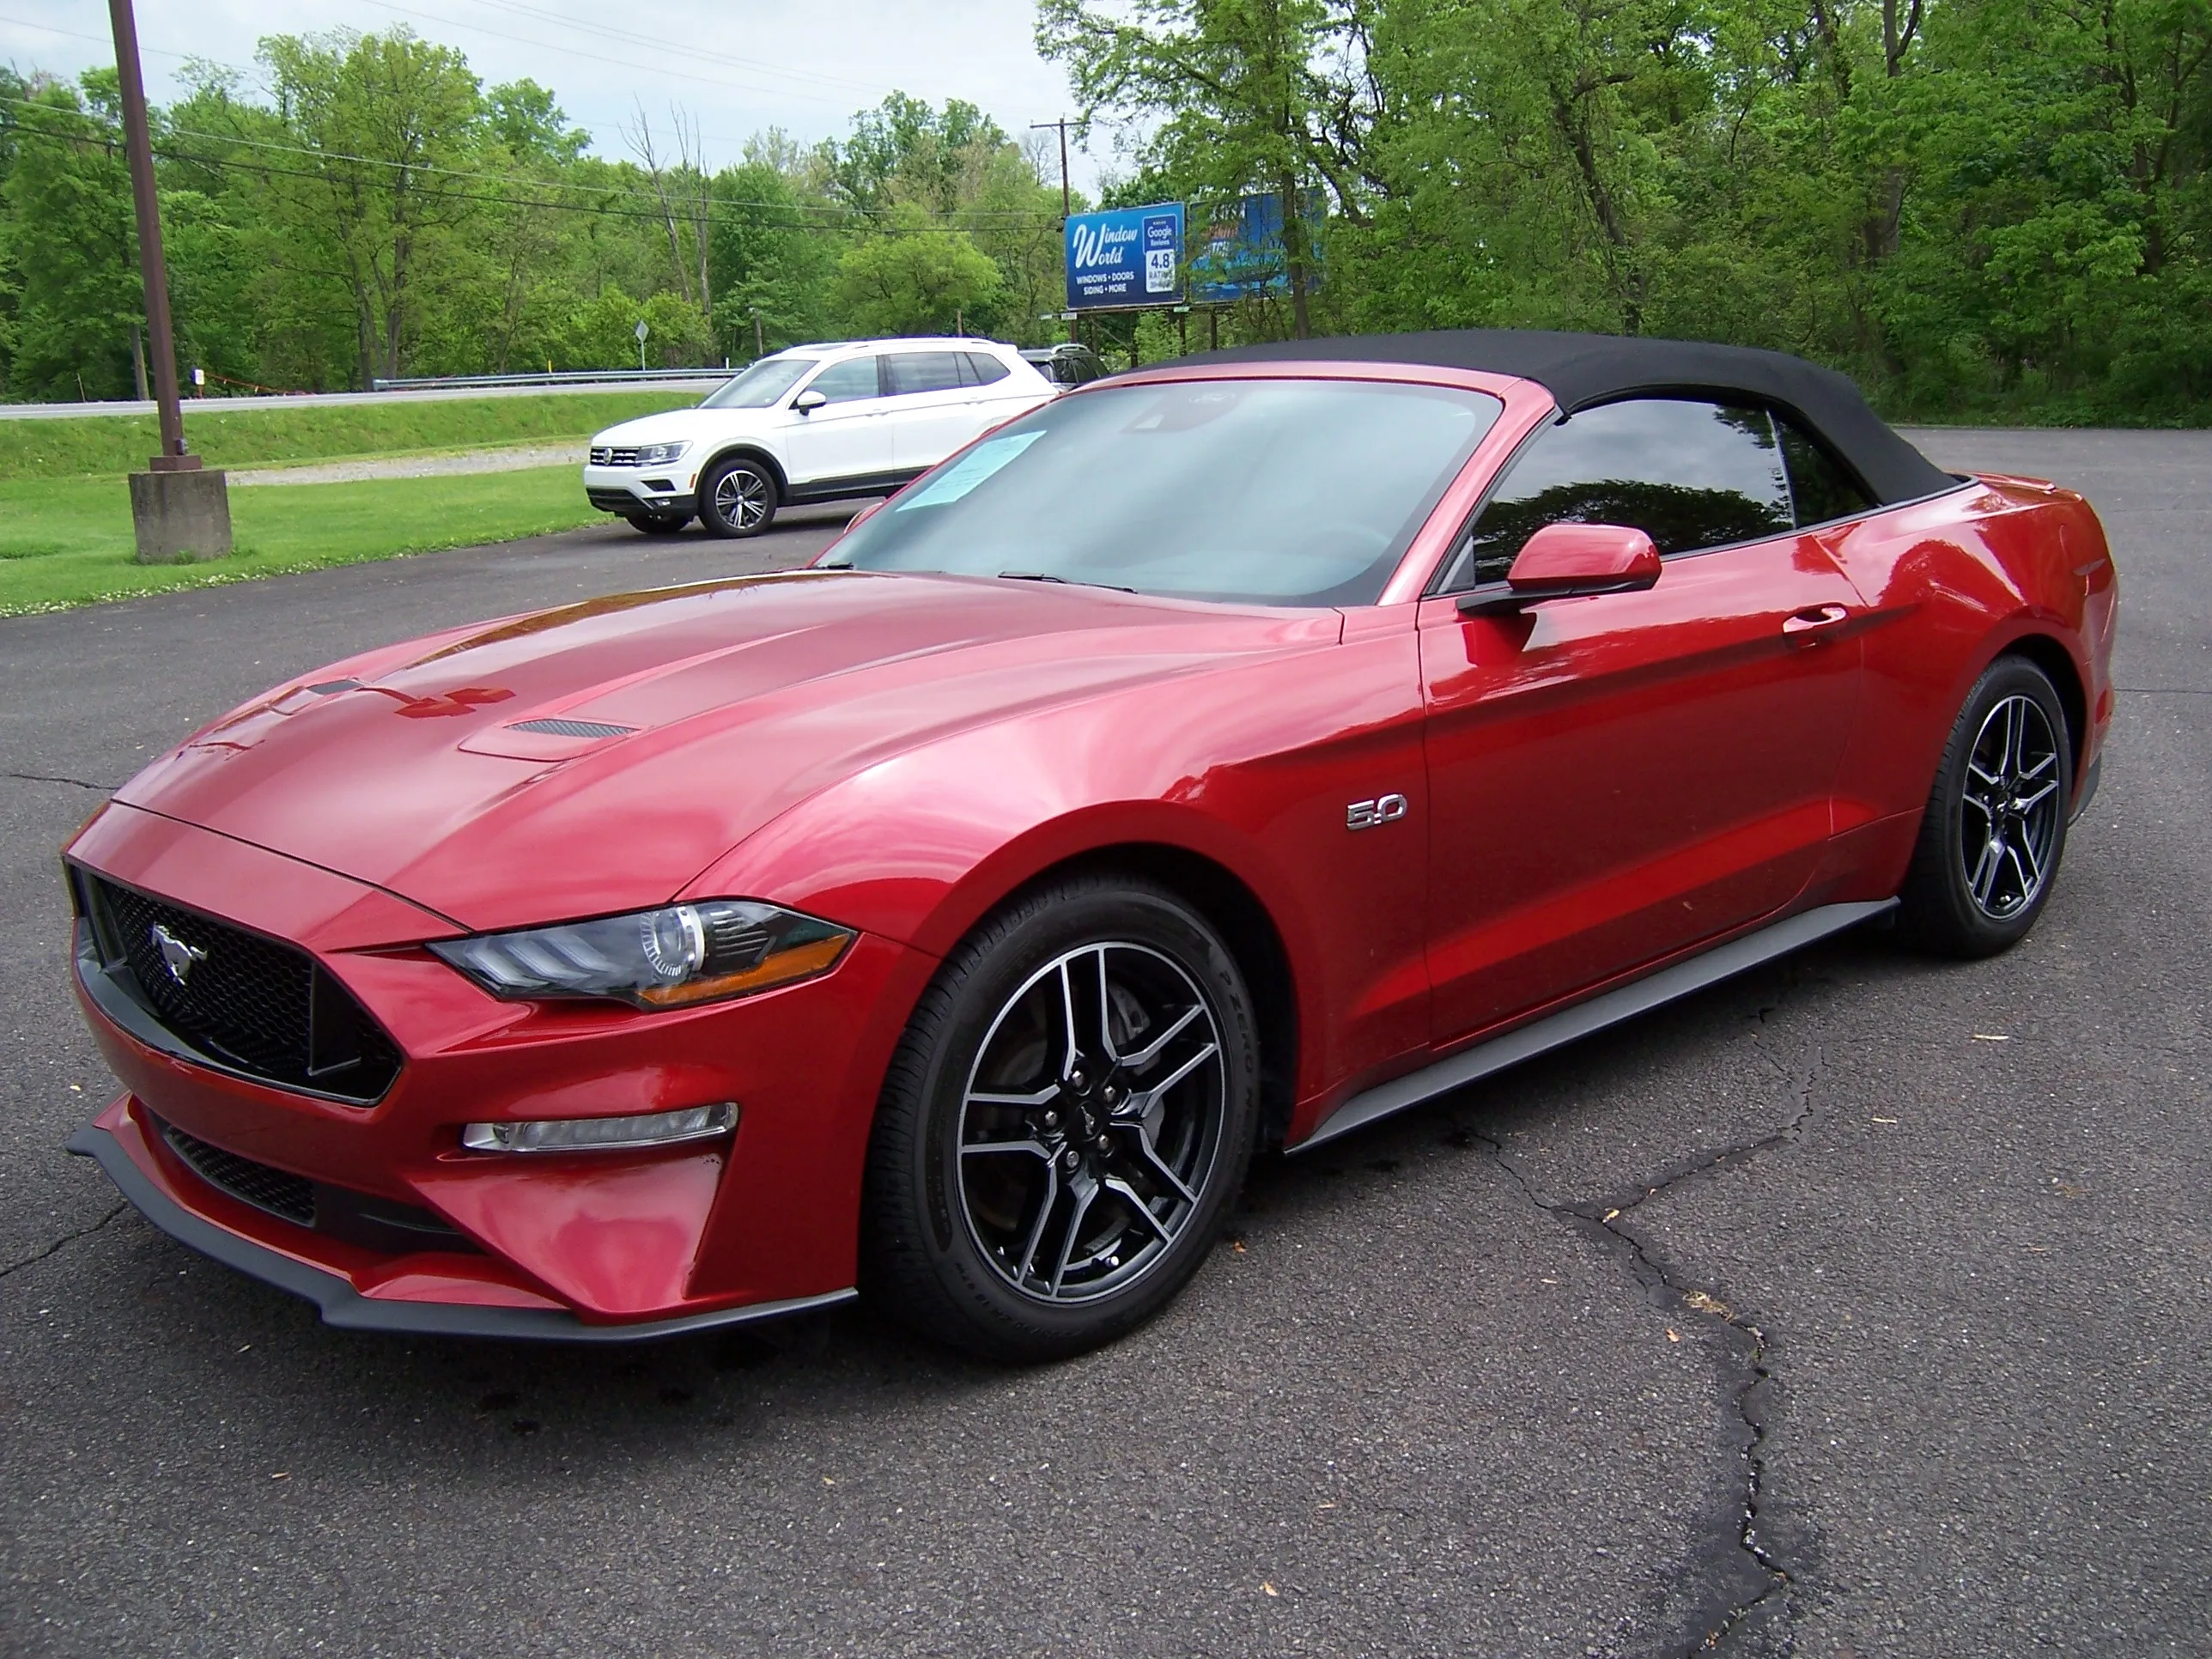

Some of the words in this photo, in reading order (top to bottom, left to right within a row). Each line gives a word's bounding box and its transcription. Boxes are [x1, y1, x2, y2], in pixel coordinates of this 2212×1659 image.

[1147, 226, 1172, 240] Google
[1073, 223, 1138, 264] Window
[1151, 253, 1170, 269] 4.8
[1076, 273, 1108, 284] WINDOWS
[1112, 271, 1134, 282] DOORS
[1109, 283, 1127, 293] MORE
[1346, 794, 1407, 830] 5.0
